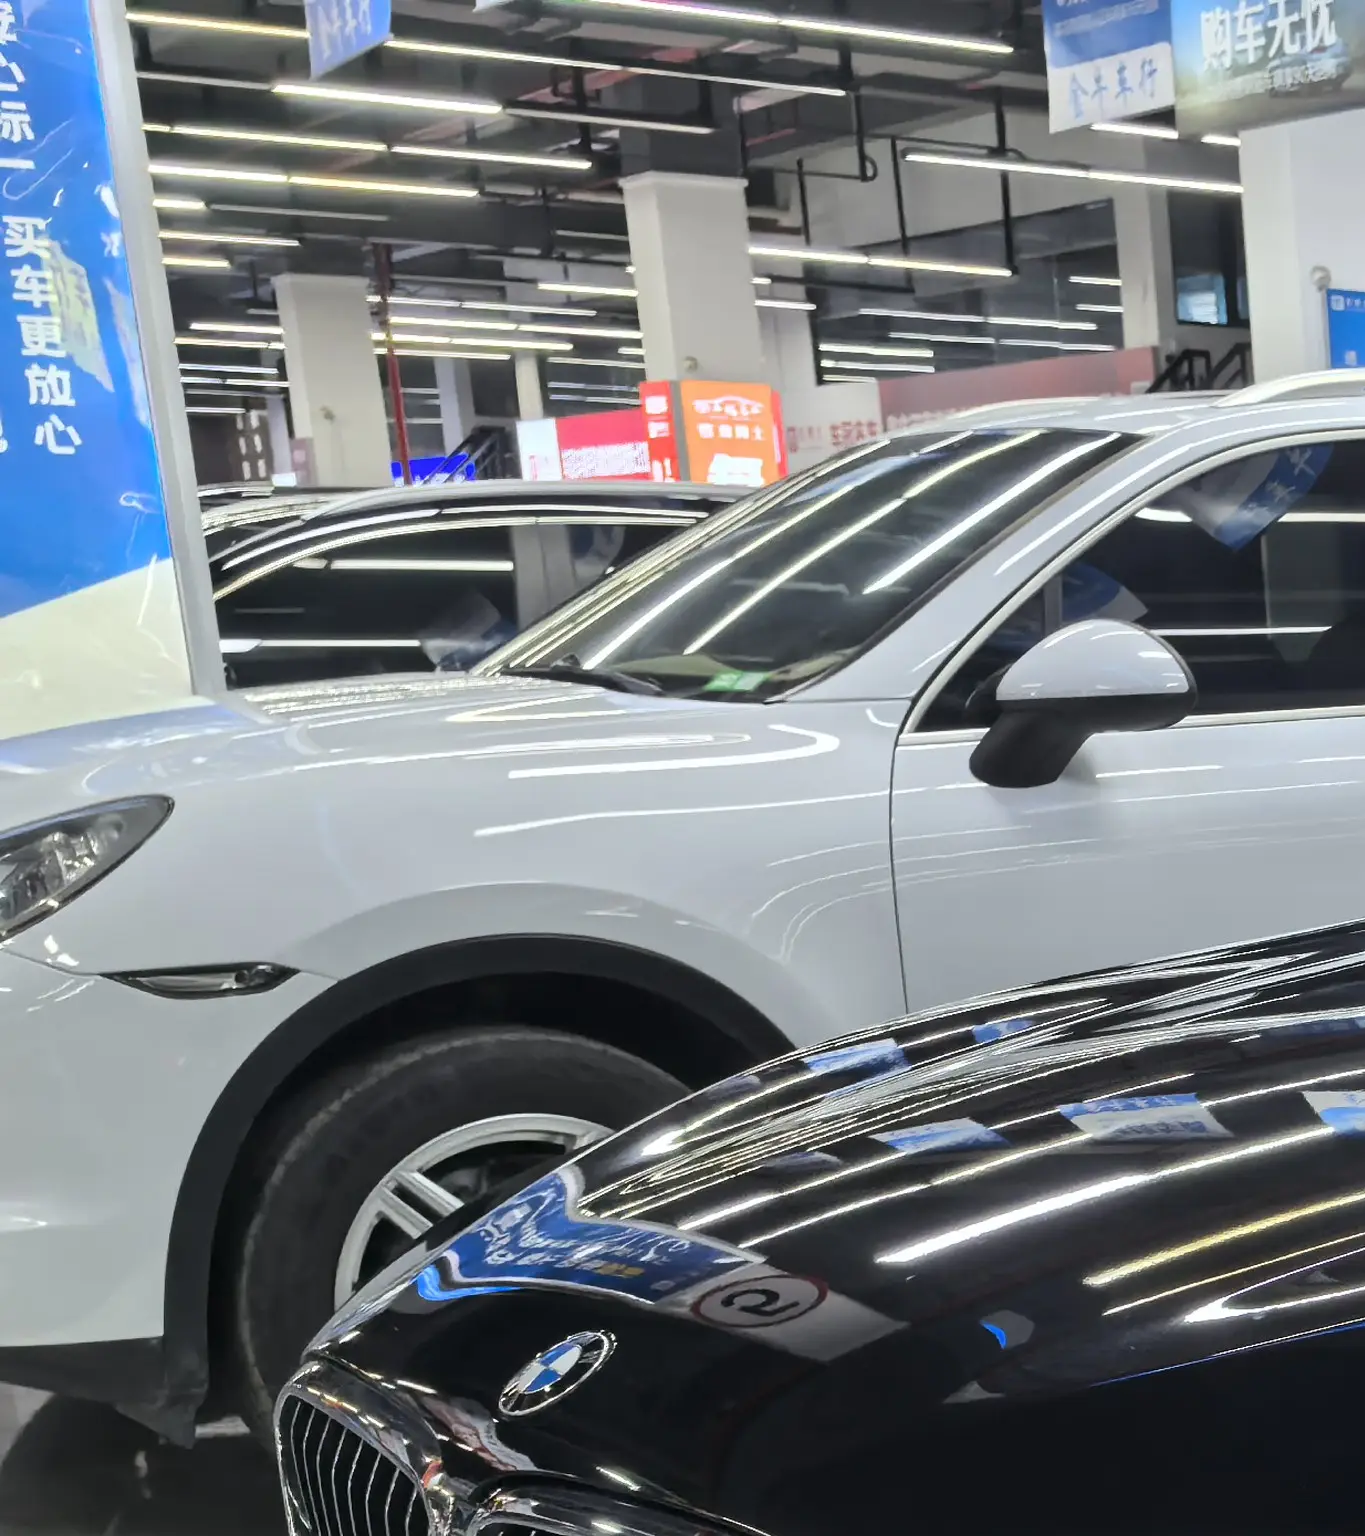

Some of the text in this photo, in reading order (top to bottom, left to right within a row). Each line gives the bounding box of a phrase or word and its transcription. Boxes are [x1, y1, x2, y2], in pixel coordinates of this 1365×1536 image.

[1201, 0, 1337, 72] 购车无忧
[1067, 57, 1159, 120] 金牛车行
[2, 215, 83, 455] 买车更放心
